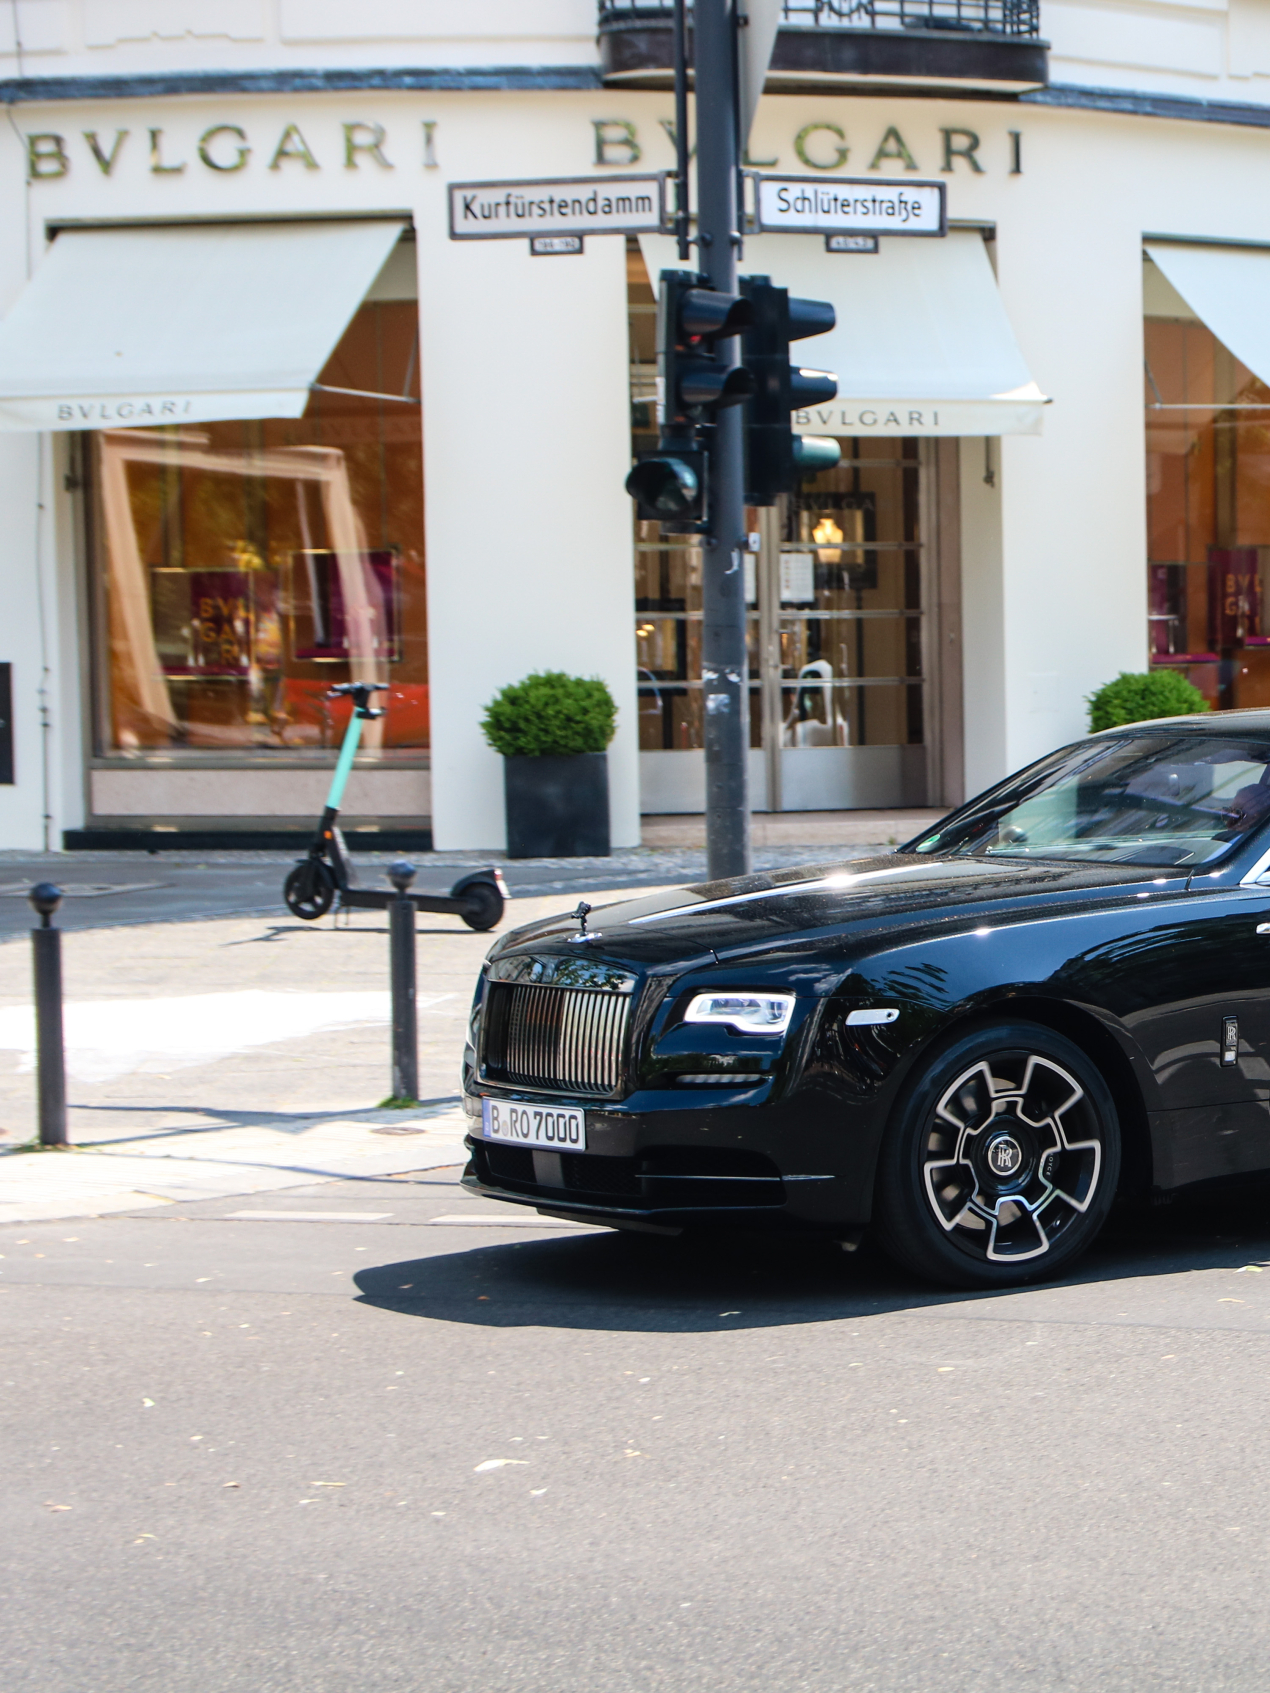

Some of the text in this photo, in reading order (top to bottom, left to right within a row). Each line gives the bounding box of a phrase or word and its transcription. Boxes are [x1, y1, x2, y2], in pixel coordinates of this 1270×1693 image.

[27, 121, 439, 179] BVLGARI
[462, 189, 653, 221] Kurfürstendamm
[777, 187, 922, 222] Schlüterstraße
[57, 399, 192, 421] BVLGARI
[795, 409, 940, 426] BVLGARI
[491, 1105, 500, 1134] B
[533, 1110, 579, 1144] 7000
[1046, 1153, 1054, 1176] OYCE
